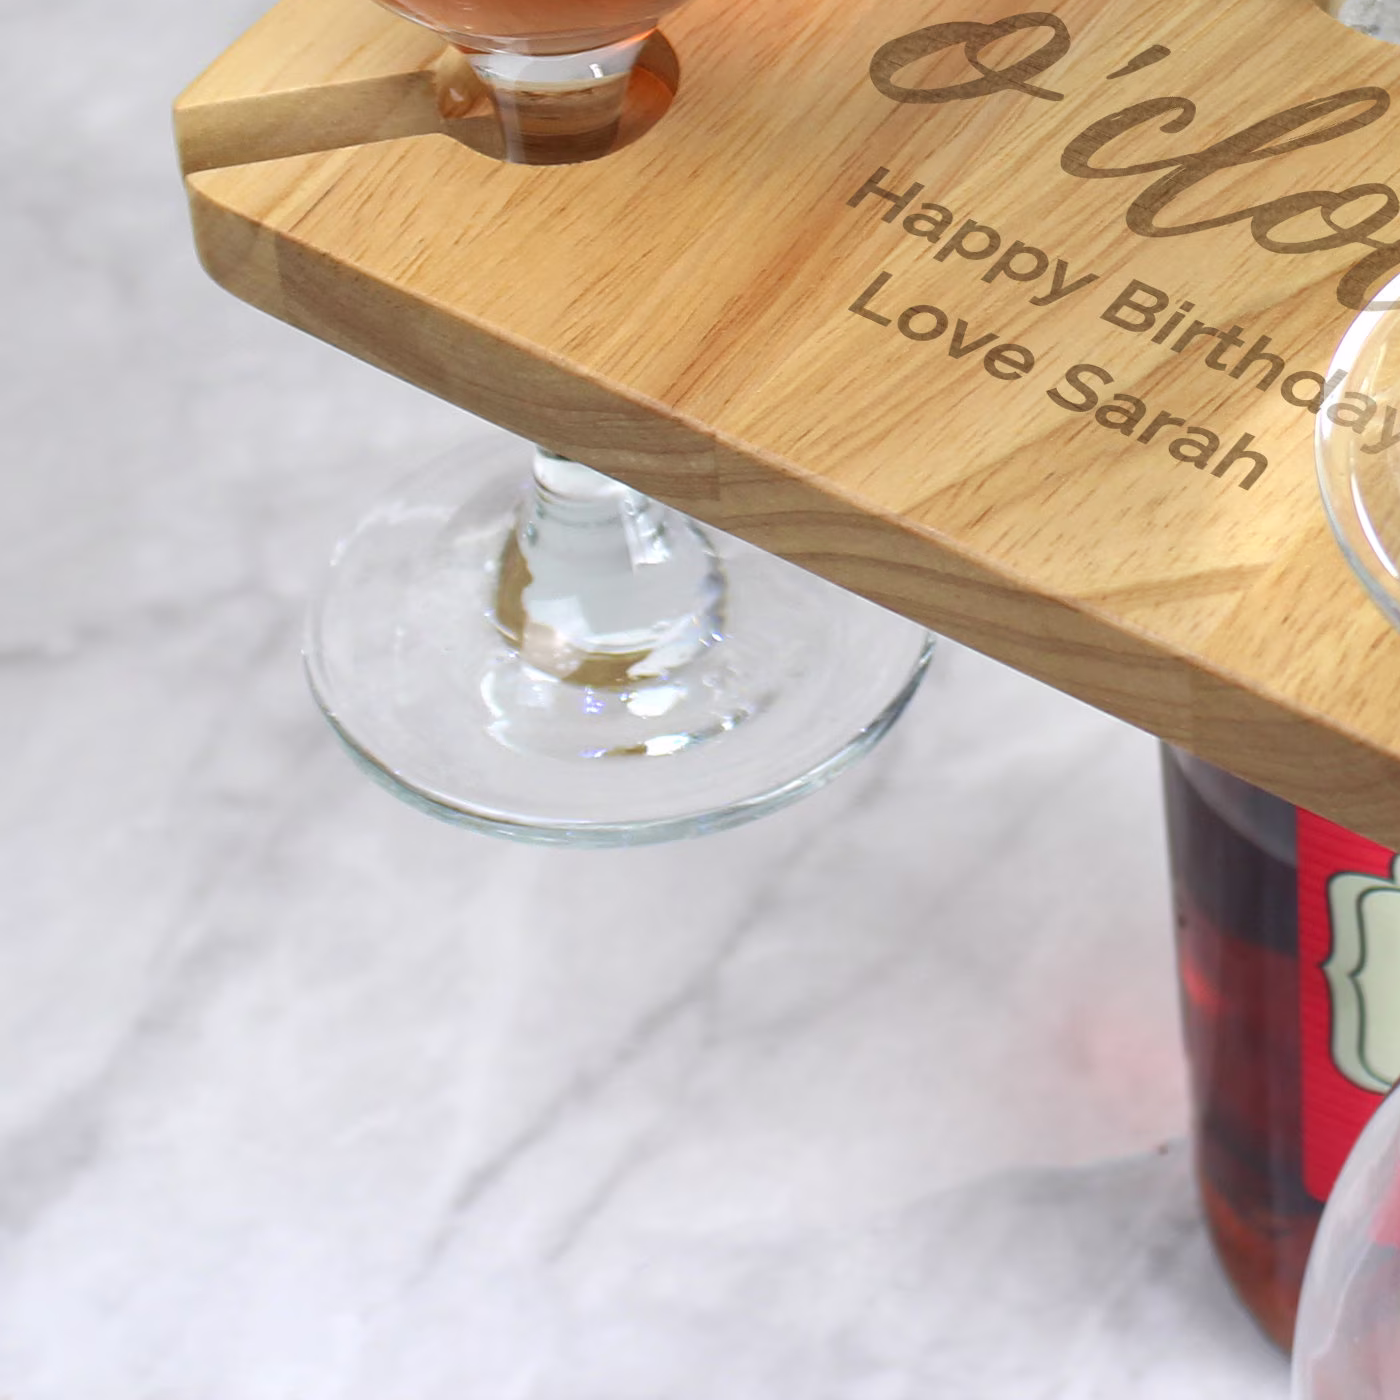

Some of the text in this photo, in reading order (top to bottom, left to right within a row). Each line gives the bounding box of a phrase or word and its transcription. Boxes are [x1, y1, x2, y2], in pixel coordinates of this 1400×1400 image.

[845, 166, 1101, 308] Happy
[846, 270, 1271, 492] Love Sarah
